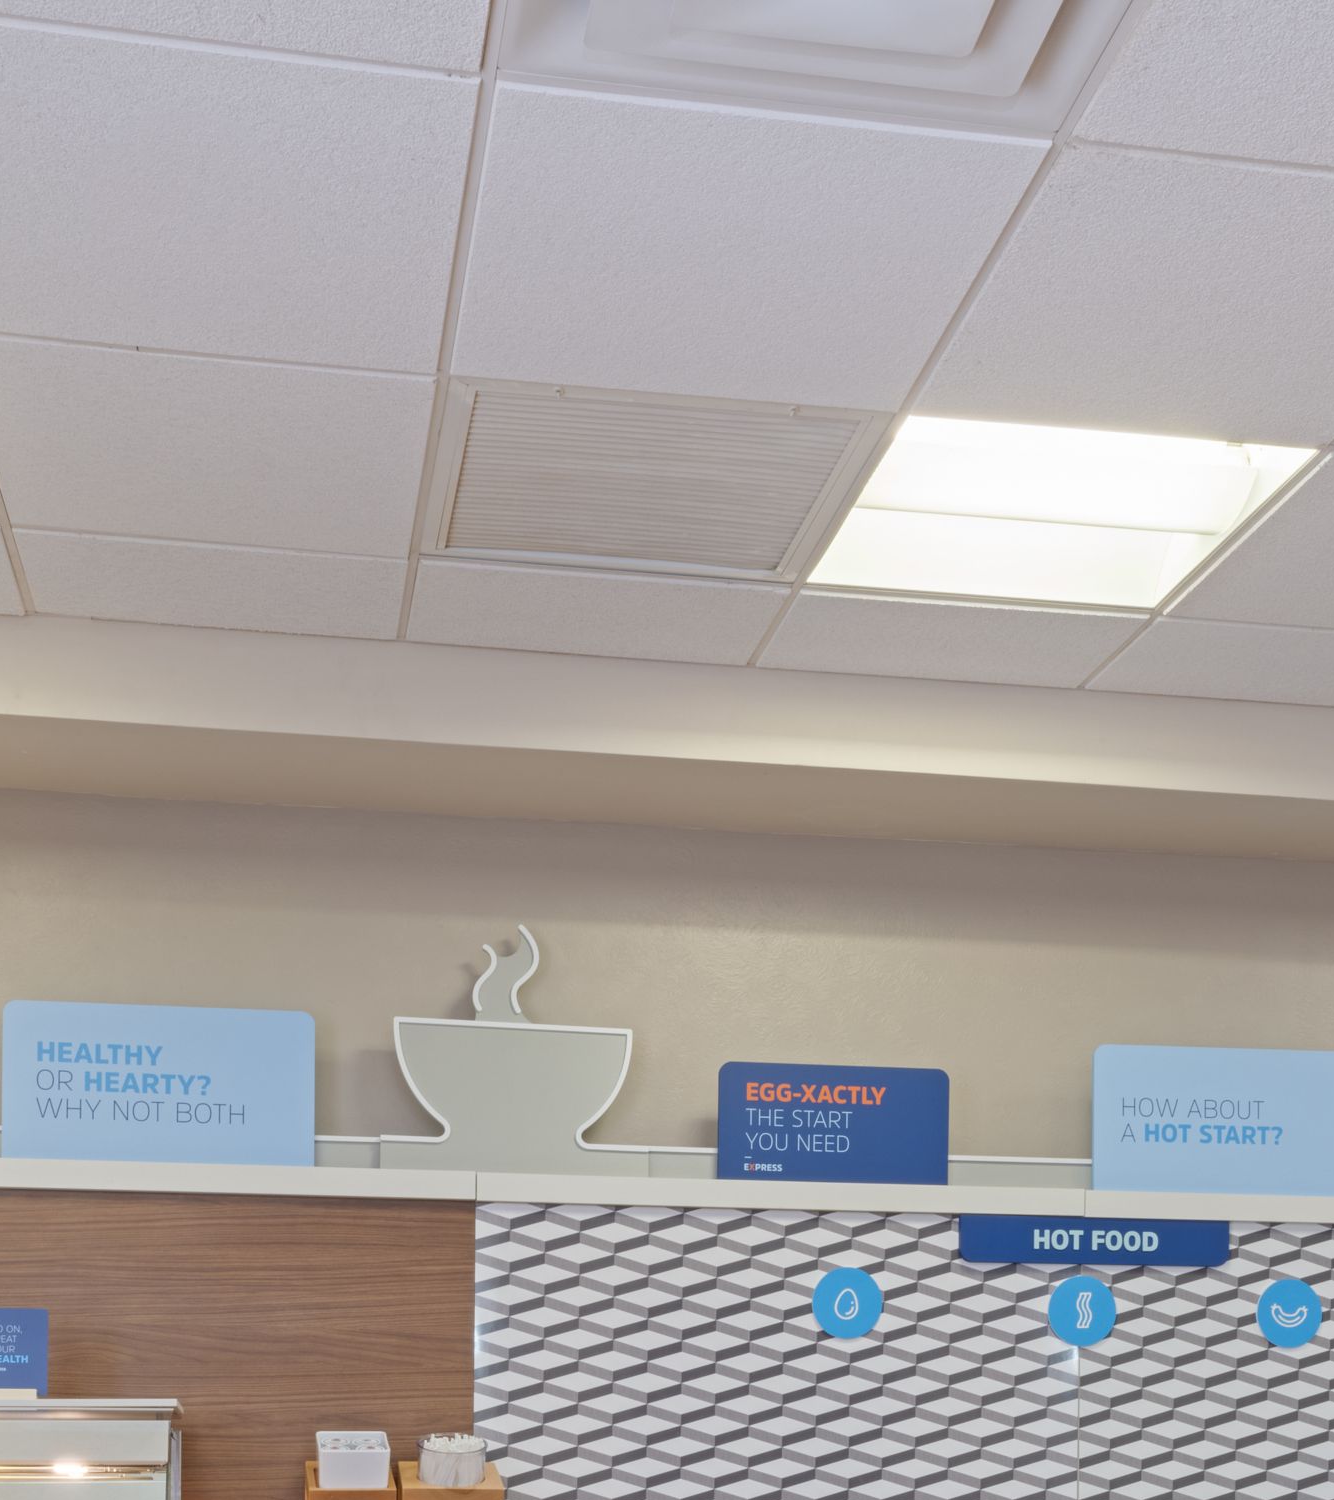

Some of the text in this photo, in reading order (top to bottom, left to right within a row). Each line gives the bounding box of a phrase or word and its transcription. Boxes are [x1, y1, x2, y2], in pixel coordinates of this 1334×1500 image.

[37, 1041, 163, 1066] HEALTHY
[36, 1069, 212, 1096] OR HEARTY?
[746, 1082, 886, 1105] EGG-XACTLY
[36, 1097, 245, 1124] WHY NOT BOTH
[745, 1108, 853, 1129] THE START
[1122, 1097, 1266, 1120] HOW ABOUT
[745, 1132, 850, 1153] YOU NEED
[1120, 1123, 1283, 1145] A HOT START?
[744, 1163, 783, 1172] EXPRESS
[1033, 1229, 1159, 1252] HOT FOOD
